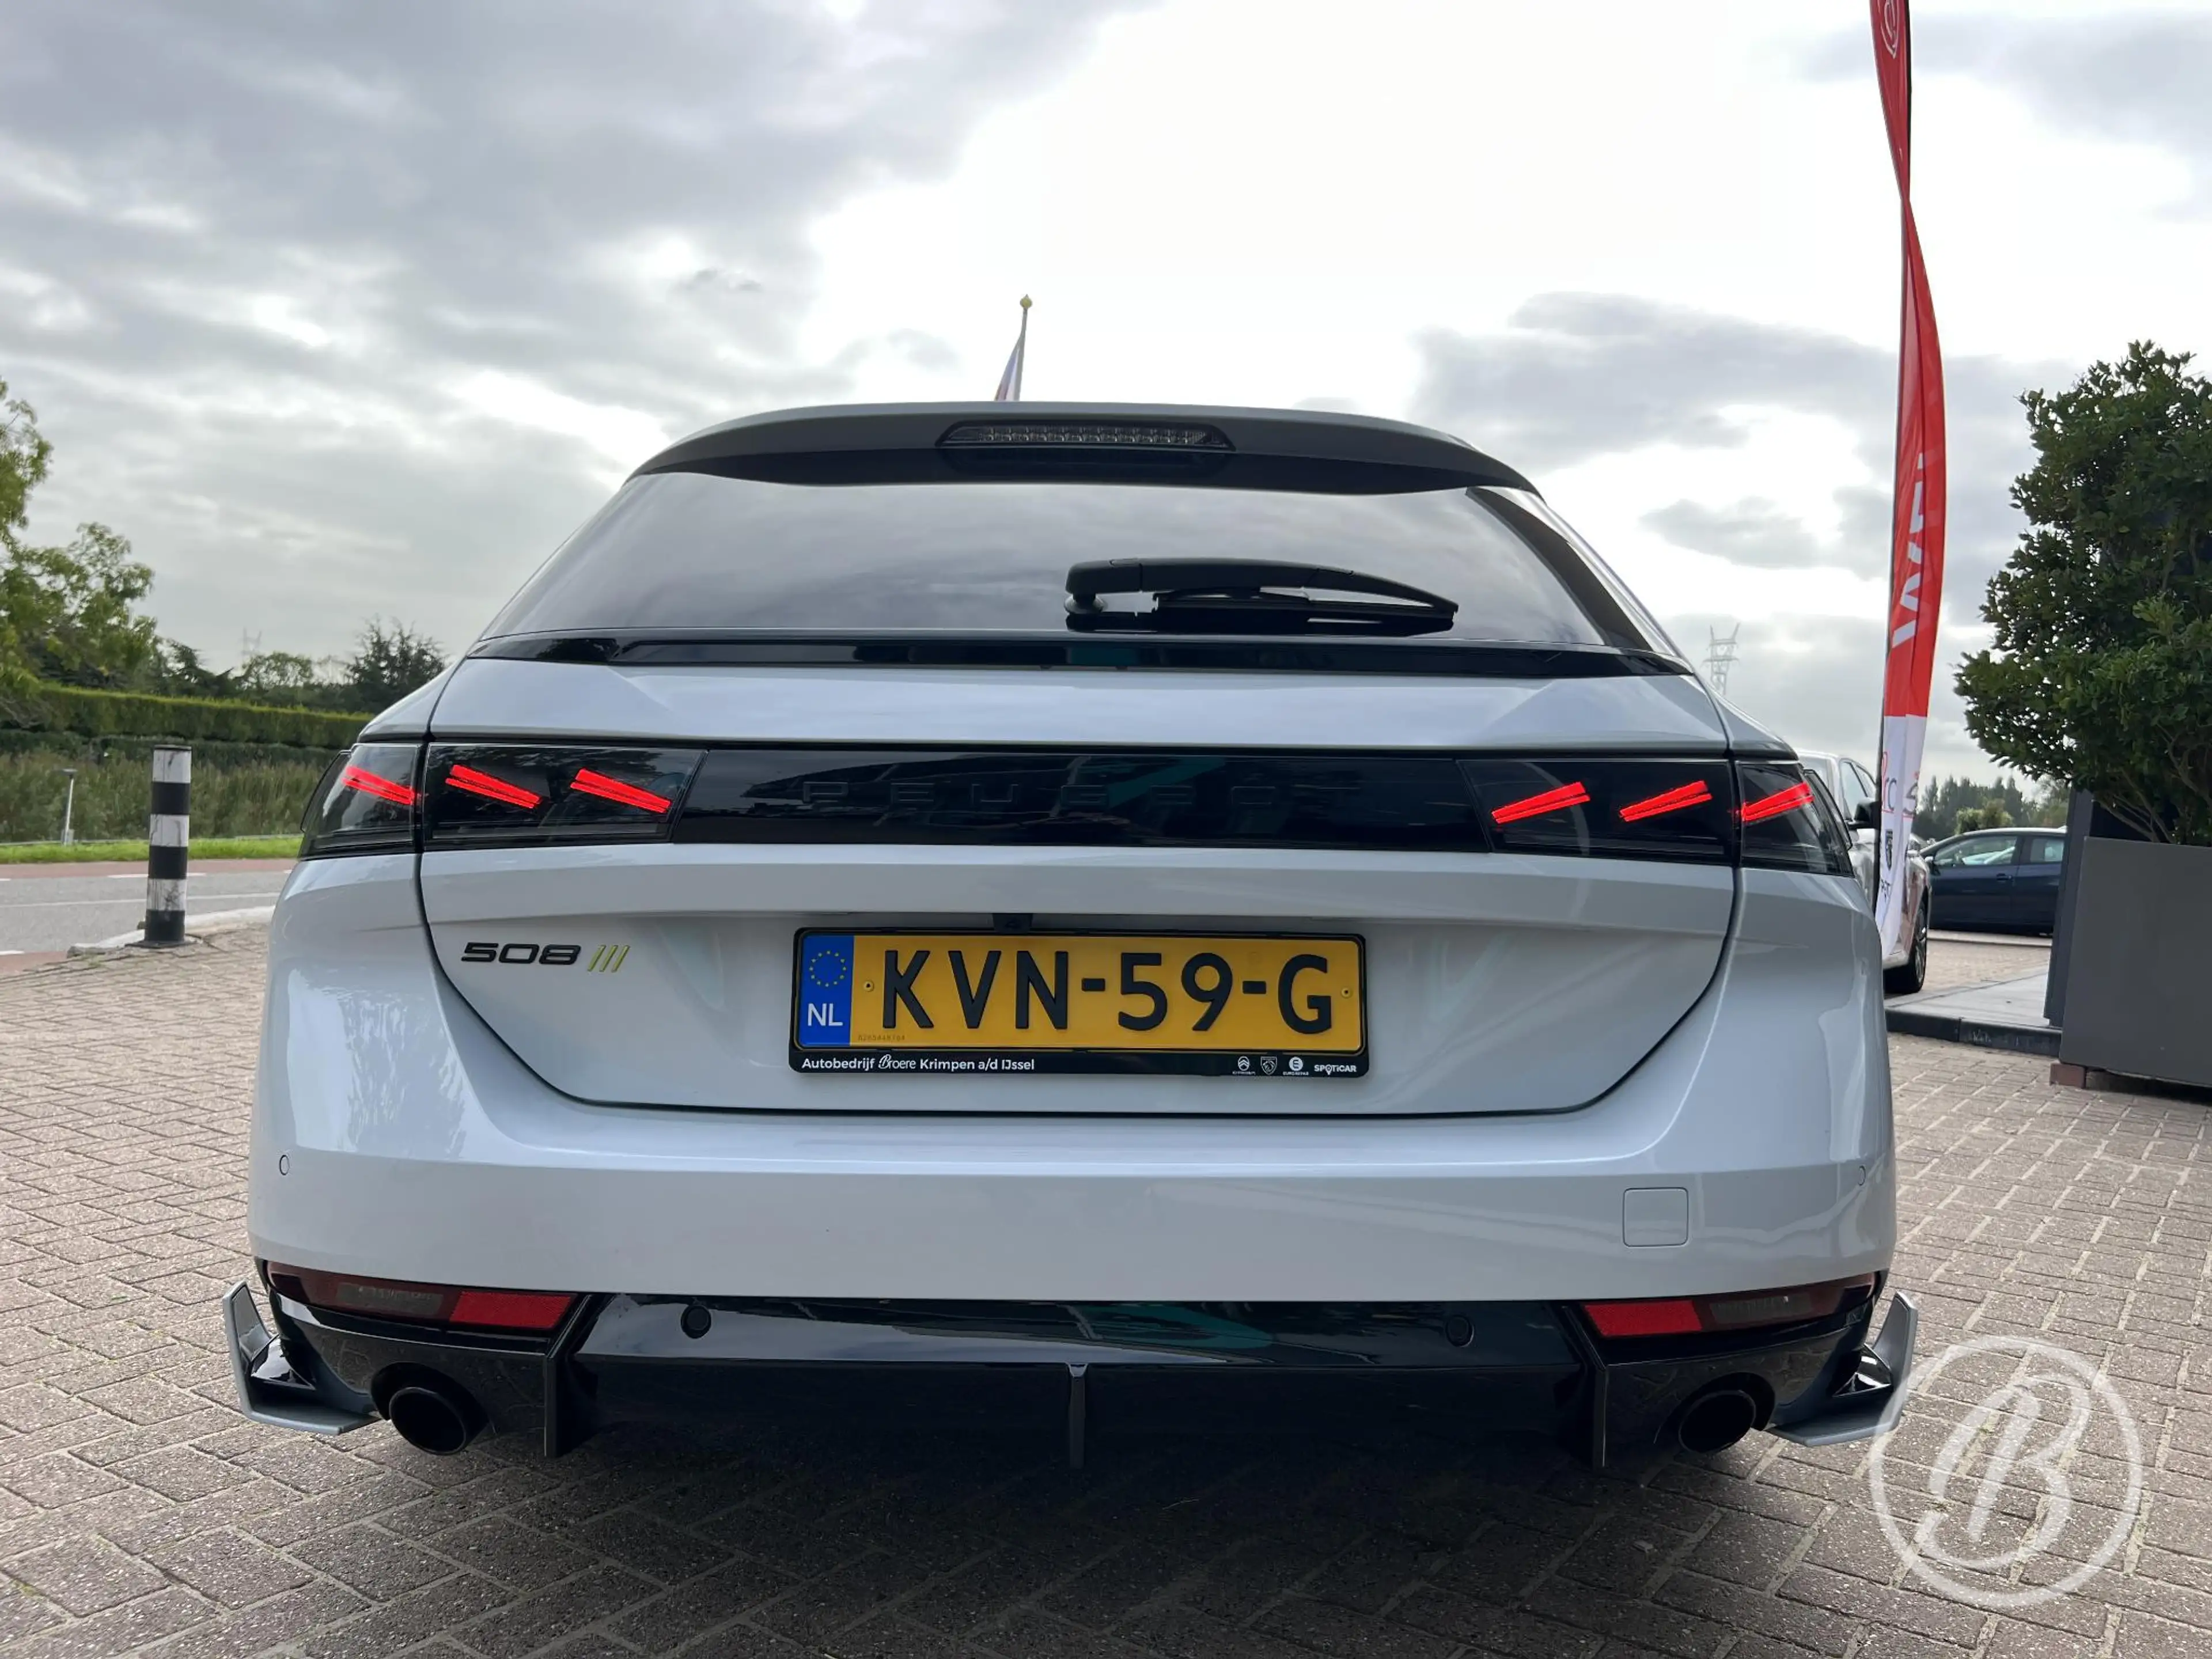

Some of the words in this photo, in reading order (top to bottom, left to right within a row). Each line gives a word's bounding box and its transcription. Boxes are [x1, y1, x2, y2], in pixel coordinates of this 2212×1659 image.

[461, 942, 582, 965] 508
[882, 949, 1332, 1035] KVN-59-G
[808, 1003, 843, 1027] NL
[801, 1057, 876, 1071] Autobedrijf
[878, 1054, 916, 1070] Broere
[920, 1058, 975, 1072] Krimpen
[978, 1058, 998, 1071] a/d
